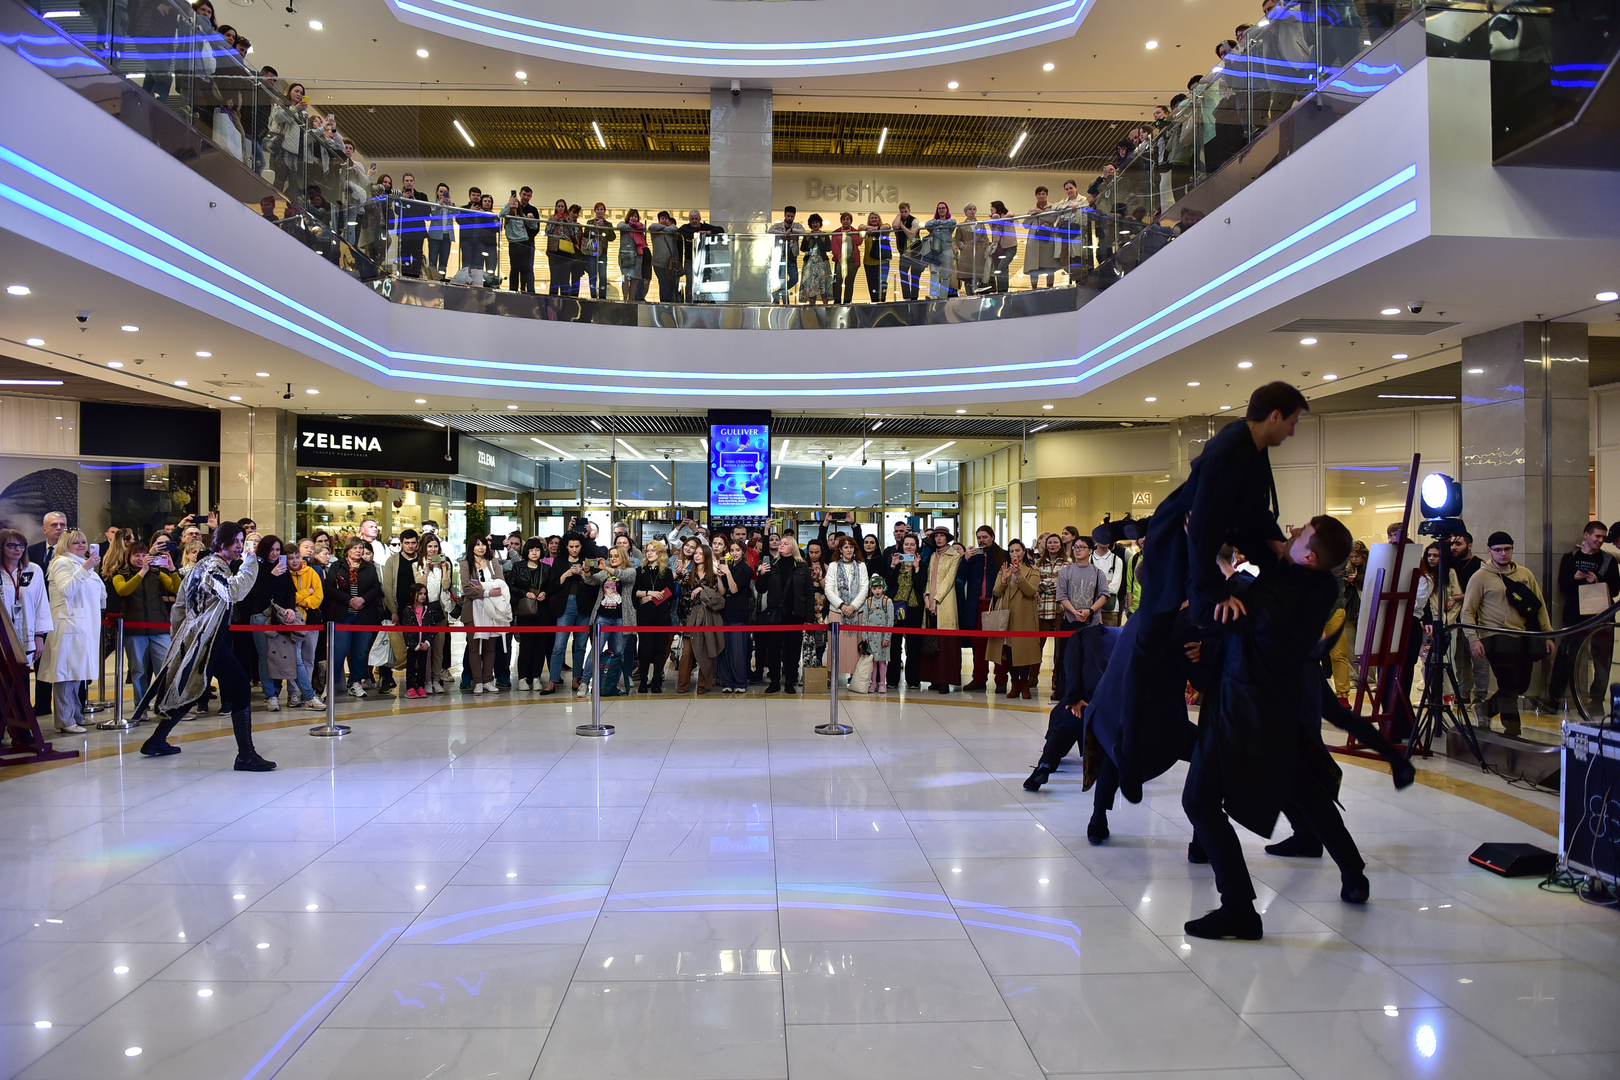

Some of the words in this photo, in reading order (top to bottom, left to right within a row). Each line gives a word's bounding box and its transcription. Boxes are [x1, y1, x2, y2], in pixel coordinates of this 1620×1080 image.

[806, 178, 899, 203] Bershka
[720, 428, 759, 436] GULLIVER
[302, 432, 382, 452] ZELENA
[478, 451, 496, 468] ZELENA
[328, 489, 364, 497] ZELENA
